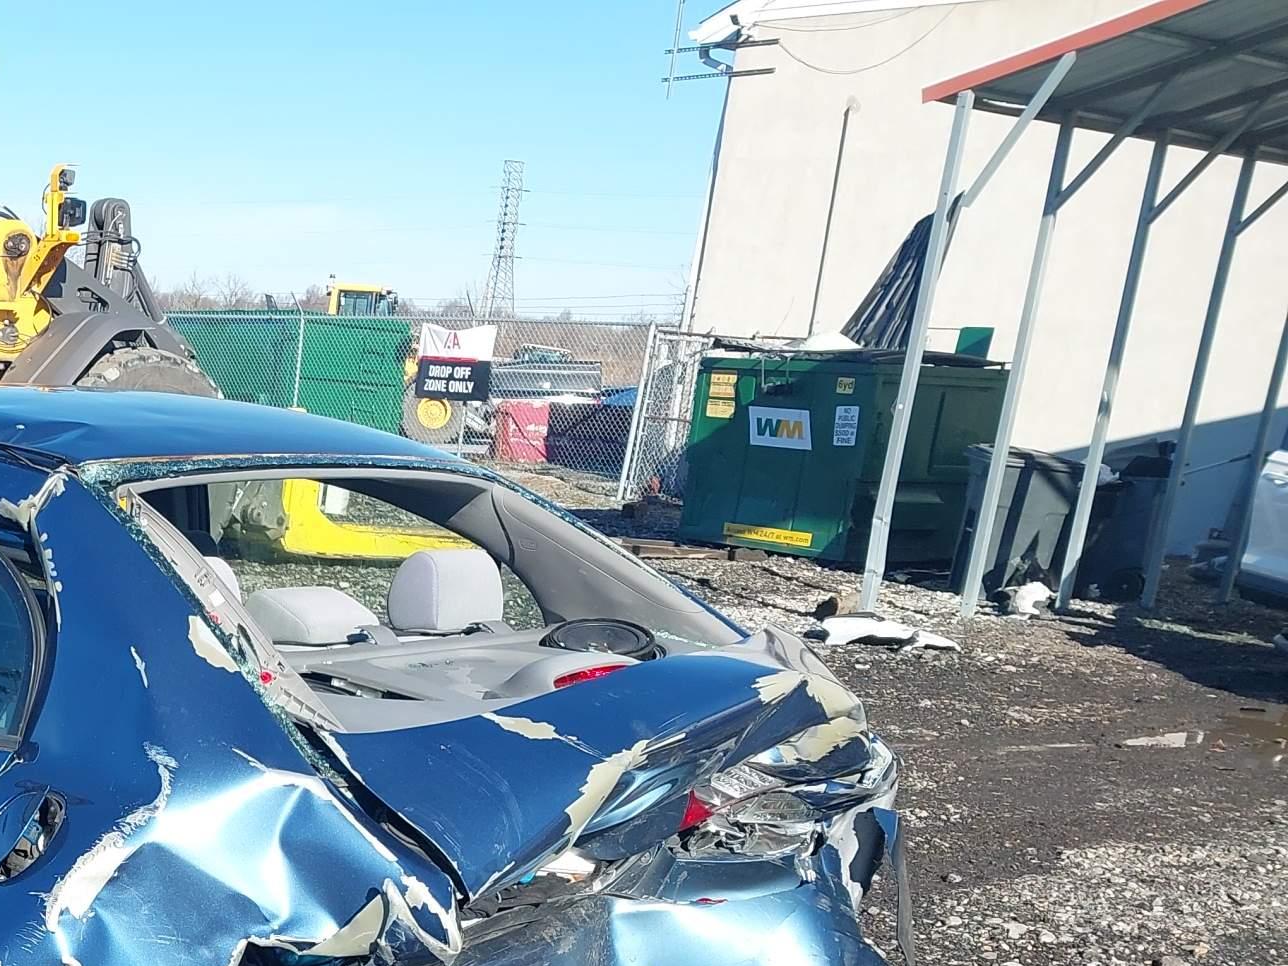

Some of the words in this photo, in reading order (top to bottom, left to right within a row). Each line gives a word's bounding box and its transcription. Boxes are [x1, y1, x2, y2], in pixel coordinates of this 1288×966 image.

[428, 365, 452, 379] DROP
[453, 366, 472, 379] OFF
[423, 379, 447, 392] ZONE
[448, 380, 474, 394] ONLY
[838, 379, 854, 391] 6yd
[756, 417, 804, 440] WM
